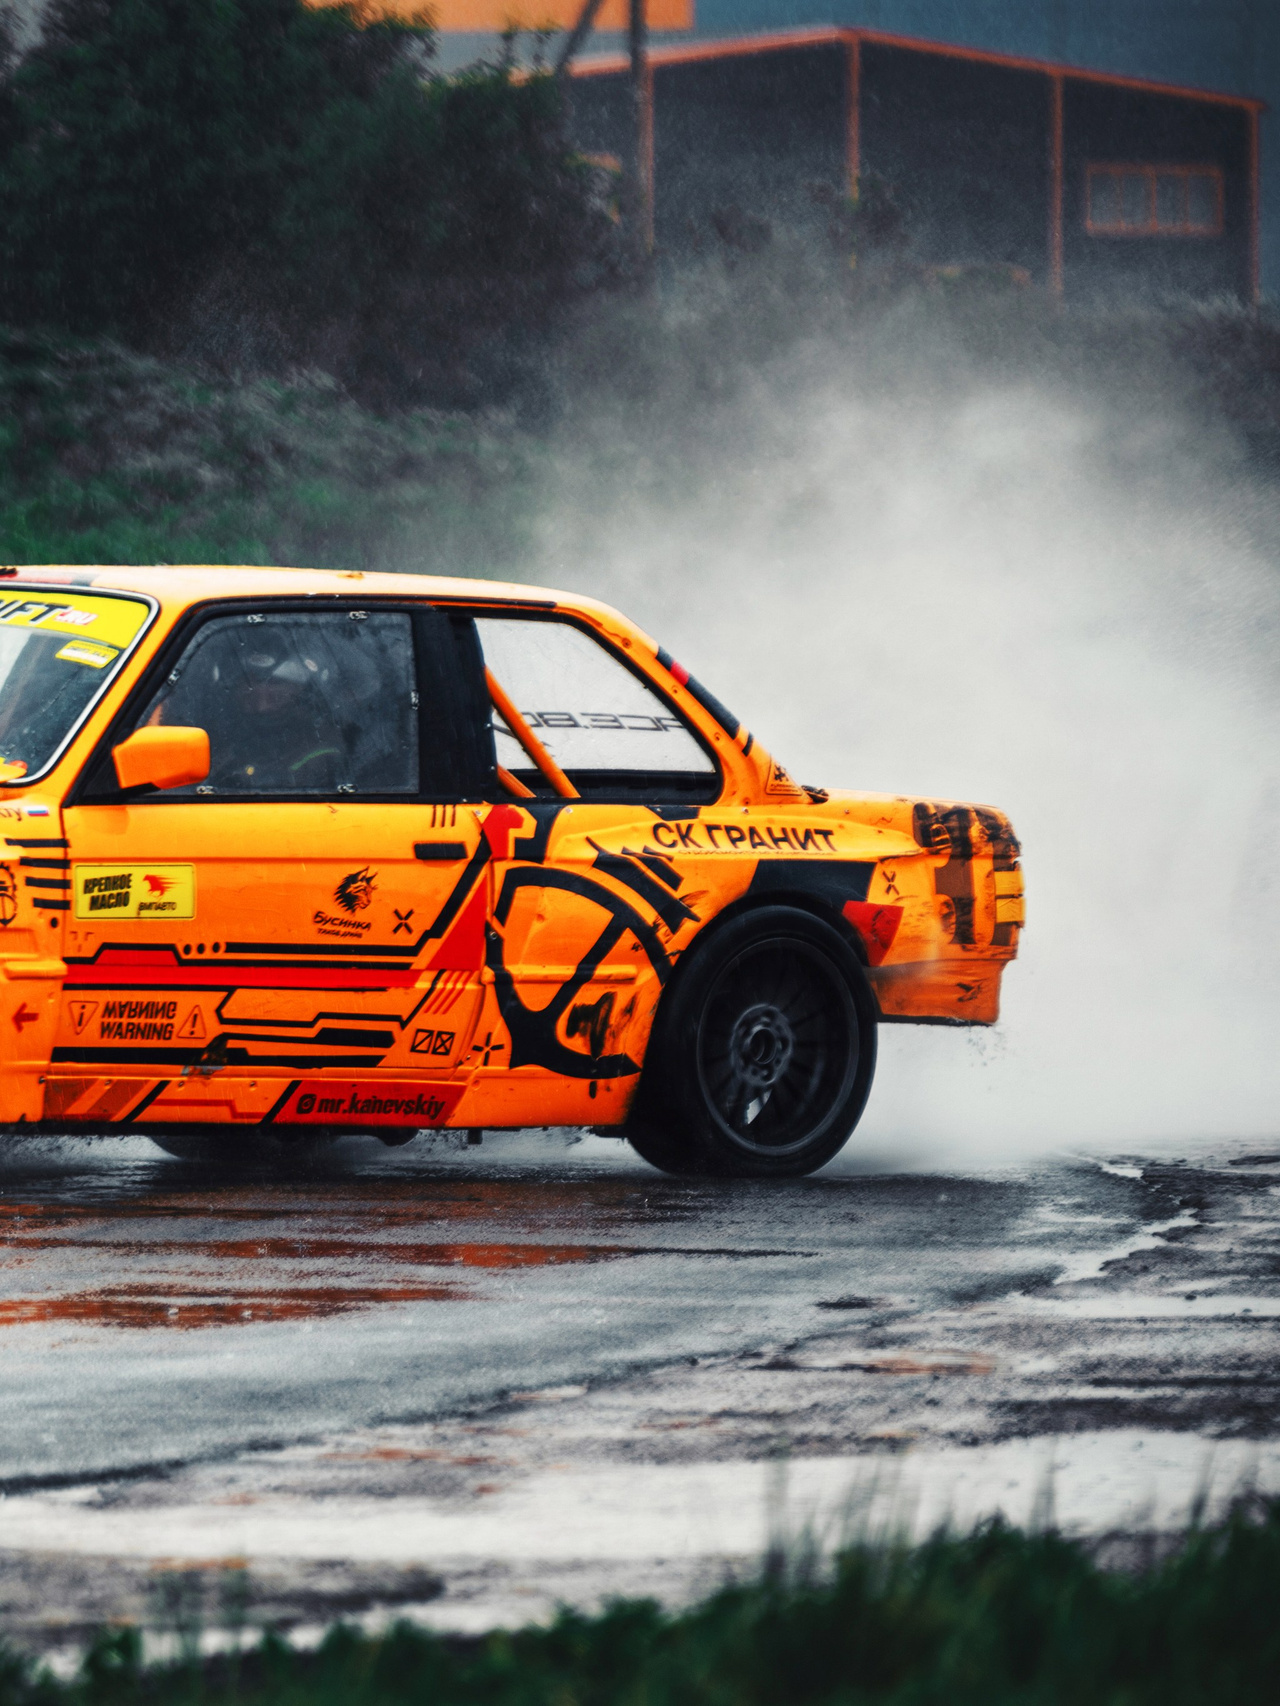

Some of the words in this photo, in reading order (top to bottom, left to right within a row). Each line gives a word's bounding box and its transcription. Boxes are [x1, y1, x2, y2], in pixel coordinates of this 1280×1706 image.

[652, 821, 704, 849] СК
[704, 823, 839, 852] ГРАНИТ
[83, 873, 133, 894] КРЕПКОЕ
[89, 891, 130, 911] МАСЛО
[100, 1021, 174, 1040] WARNING
